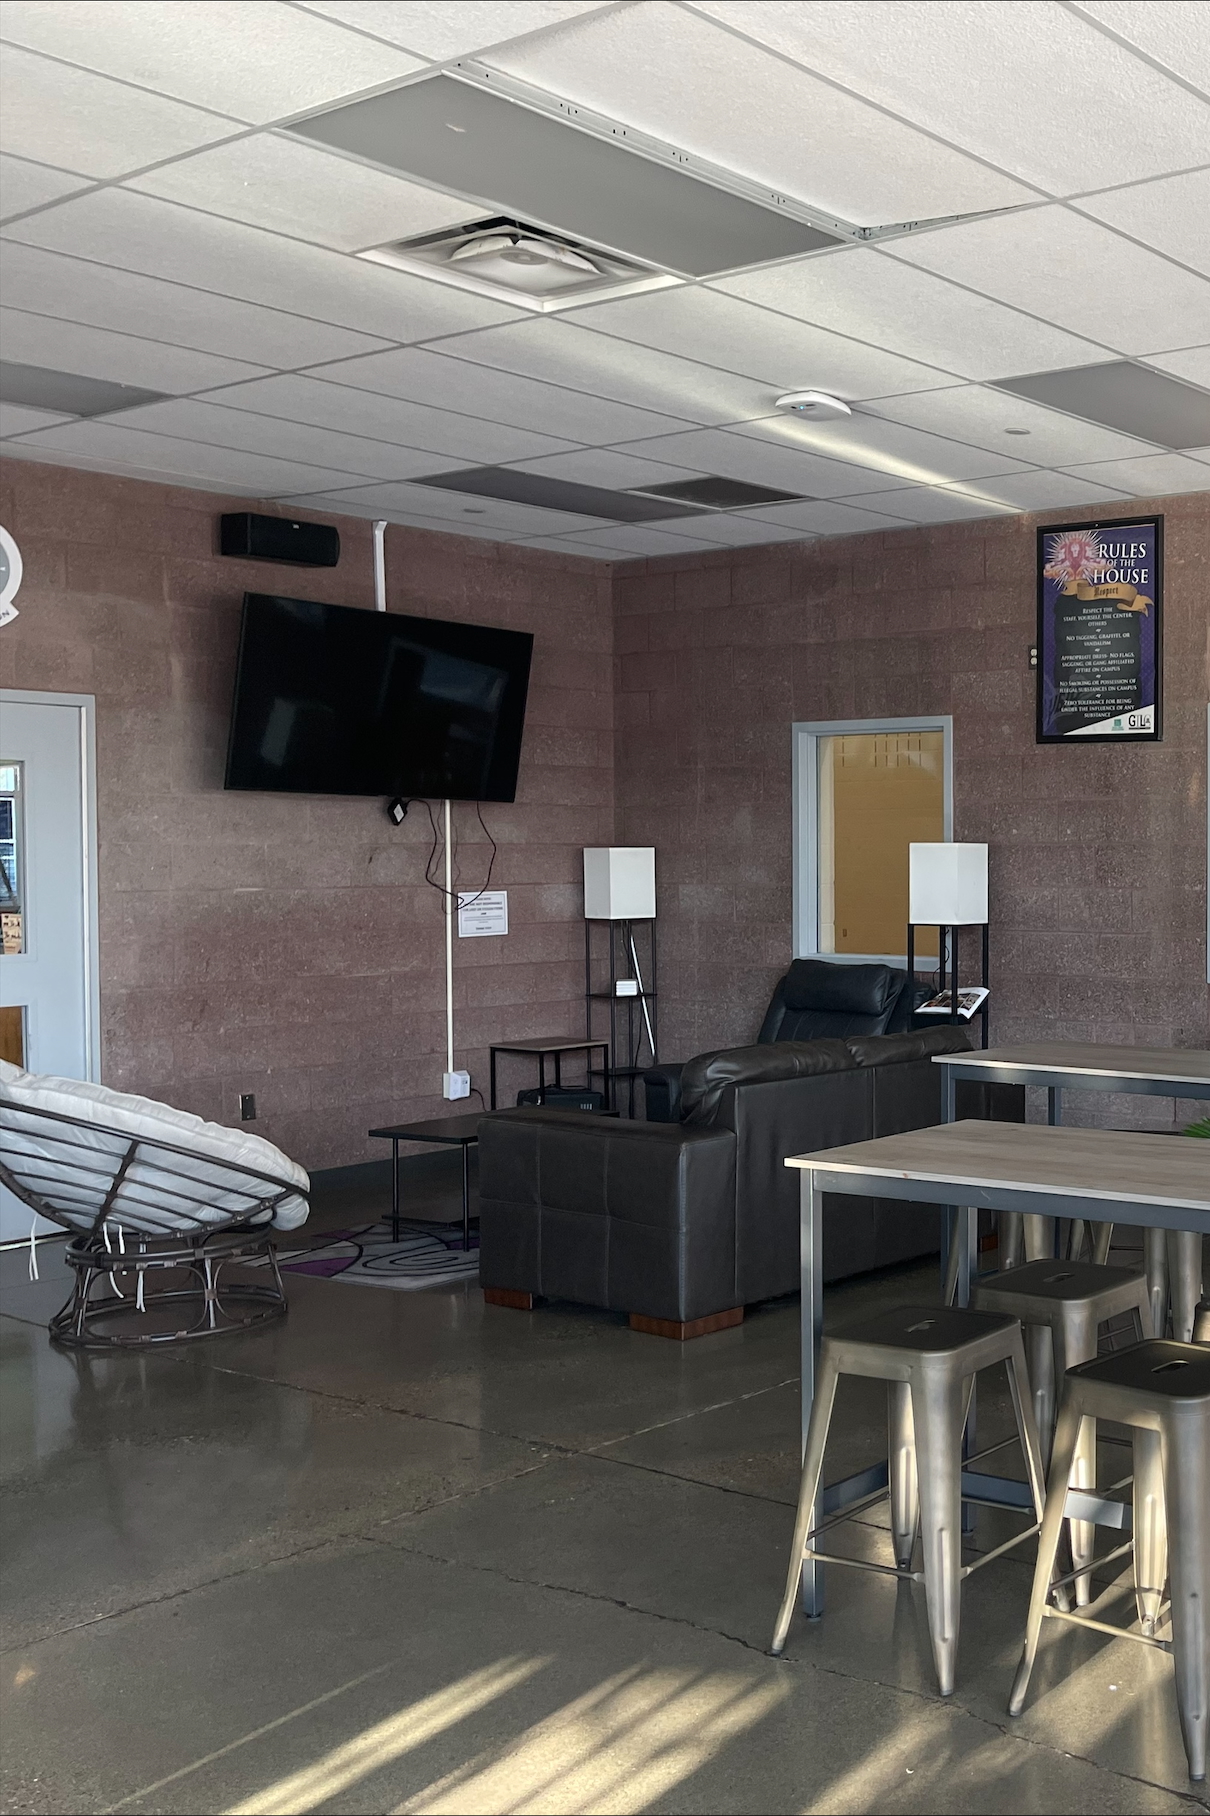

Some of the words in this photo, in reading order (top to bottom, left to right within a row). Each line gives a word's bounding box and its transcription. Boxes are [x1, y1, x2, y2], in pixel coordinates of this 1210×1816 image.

[1100, 543, 1146, 558] RULES
[1106, 559, 1117, 567] OF
[1120, 558, 1136, 567] THE
[1094, 568, 1149, 584] HOUSE
[1094, 586, 1118, 597] Respect
